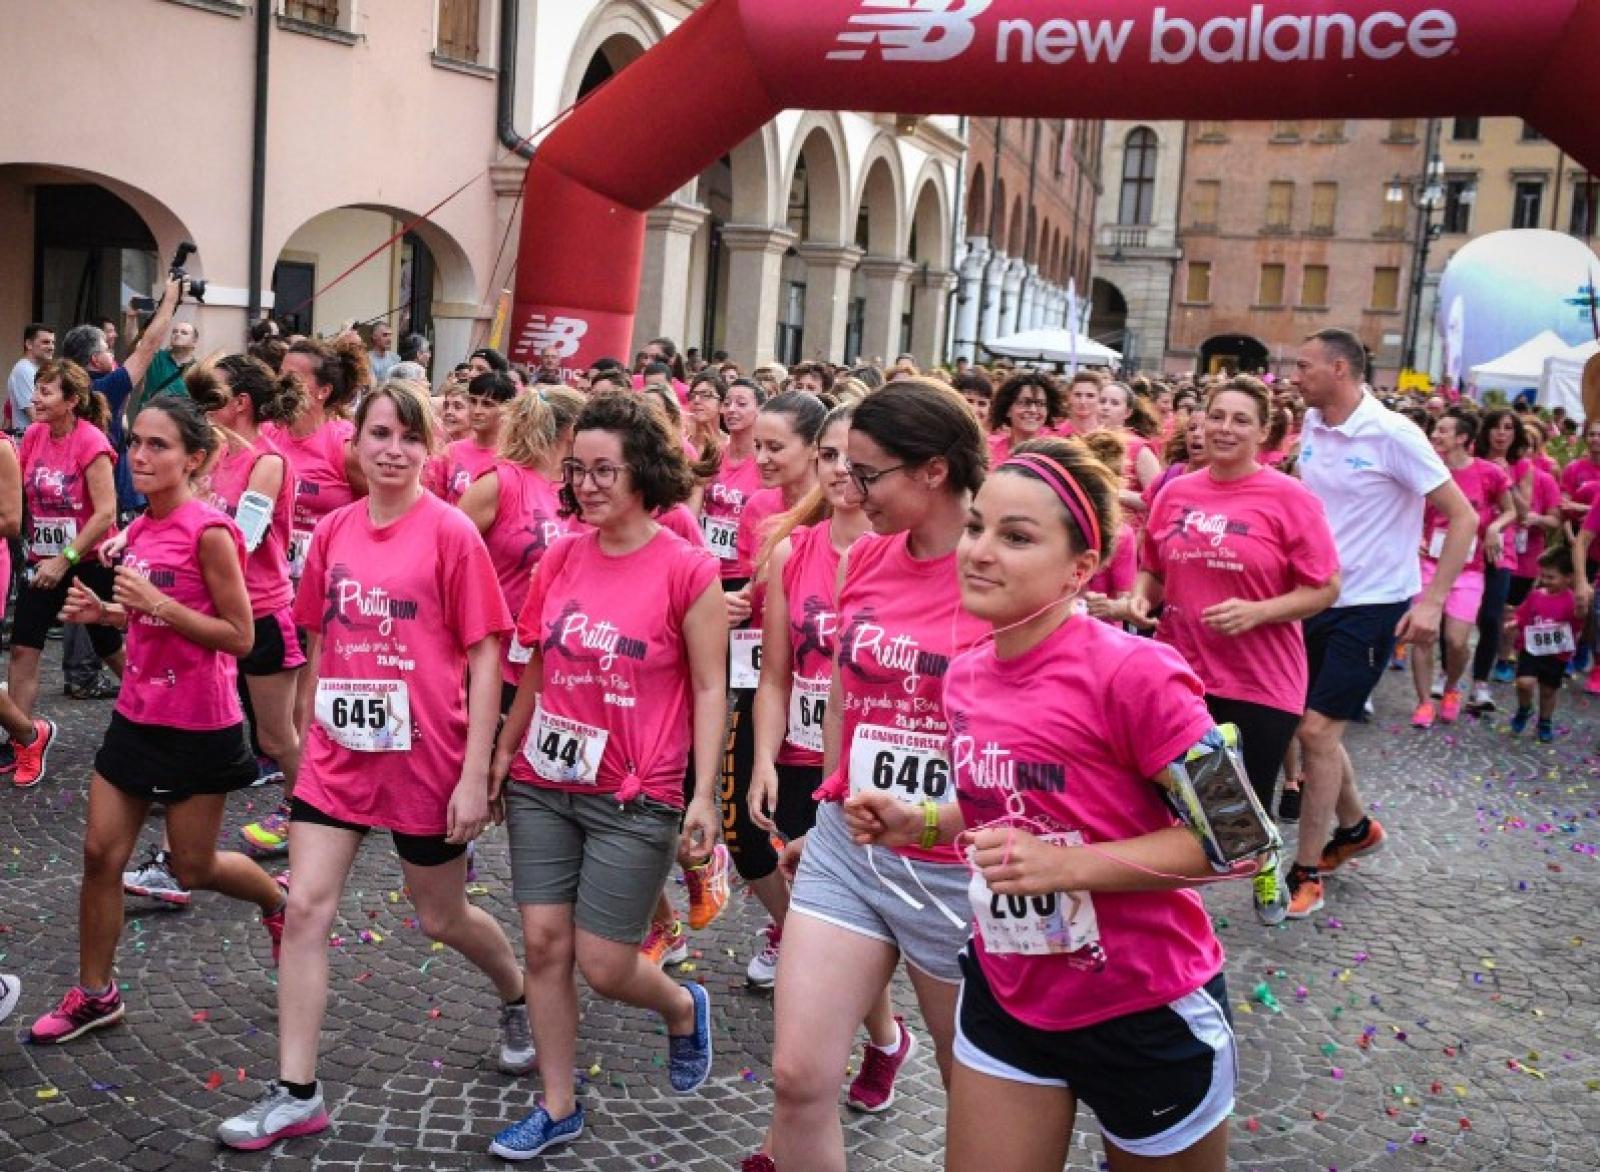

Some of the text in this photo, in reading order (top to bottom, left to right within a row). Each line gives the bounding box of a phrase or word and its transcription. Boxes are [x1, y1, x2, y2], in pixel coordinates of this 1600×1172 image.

[996, 4, 1458, 64] new balance
[851, 622, 921, 695] Pretty
[332, 697, 386, 729] 645
[871, 730, 905, 745] GRANDE
[537, 728, 579, 769] 44
[872, 749, 950, 798] 646
[952, 735, 1025, 818] Pretty
